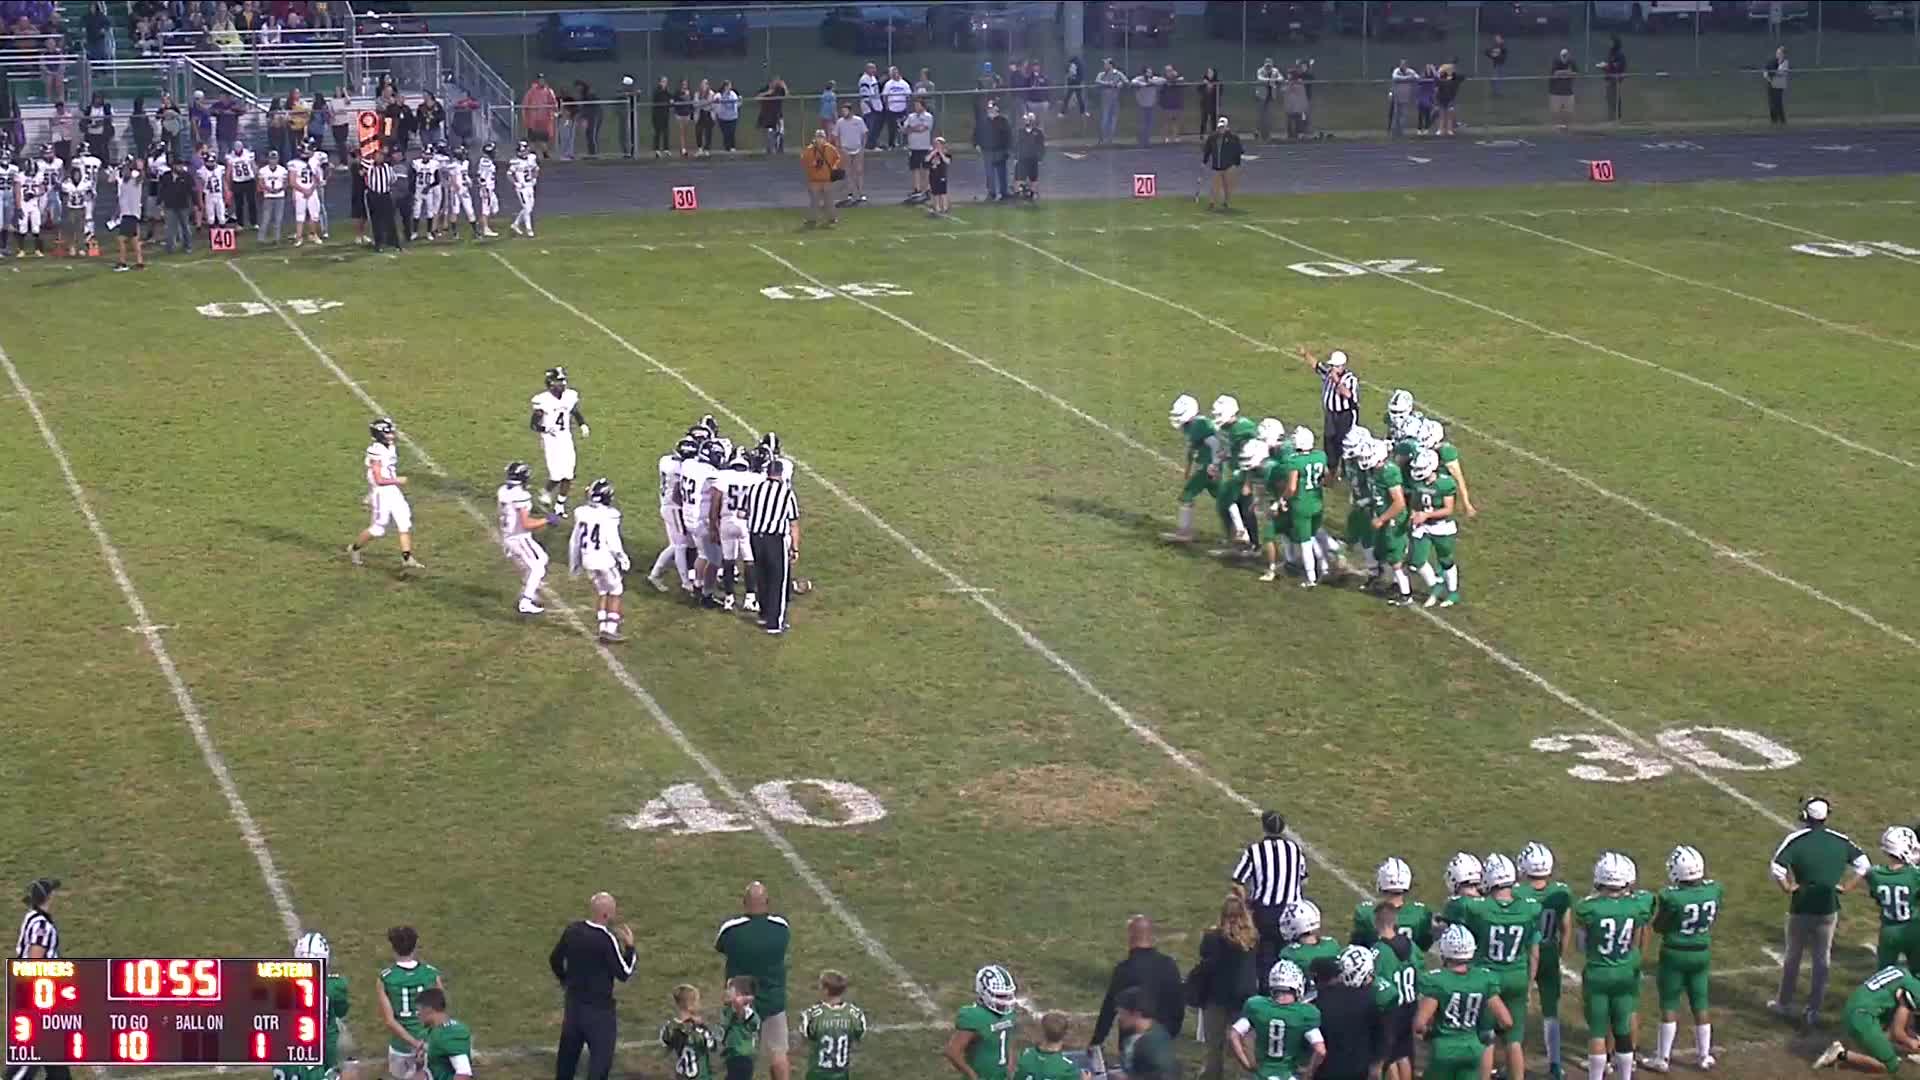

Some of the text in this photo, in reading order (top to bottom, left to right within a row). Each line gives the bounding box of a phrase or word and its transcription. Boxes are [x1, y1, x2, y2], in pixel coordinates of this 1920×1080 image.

[1136, 177, 1153, 194] 20
[1595, 162, 1611, 179] 10
[676, 190, 694, 207] 30
[213, 230, 233, 249] 40
[555, 411, 566, 432] 4
[579, 521, 601, 550] 24
[1530, 725, 1802, 783] 30
[623, 779, 888, 834] 40
[1488, 924, 1525, 963] 67
[1598, 917, 1635, 955] 34
[817, 1034, 849, 1069] 20
[998, 1029, 1008, 1066] 1
[1267, 1018, 1286, 1059] 8
